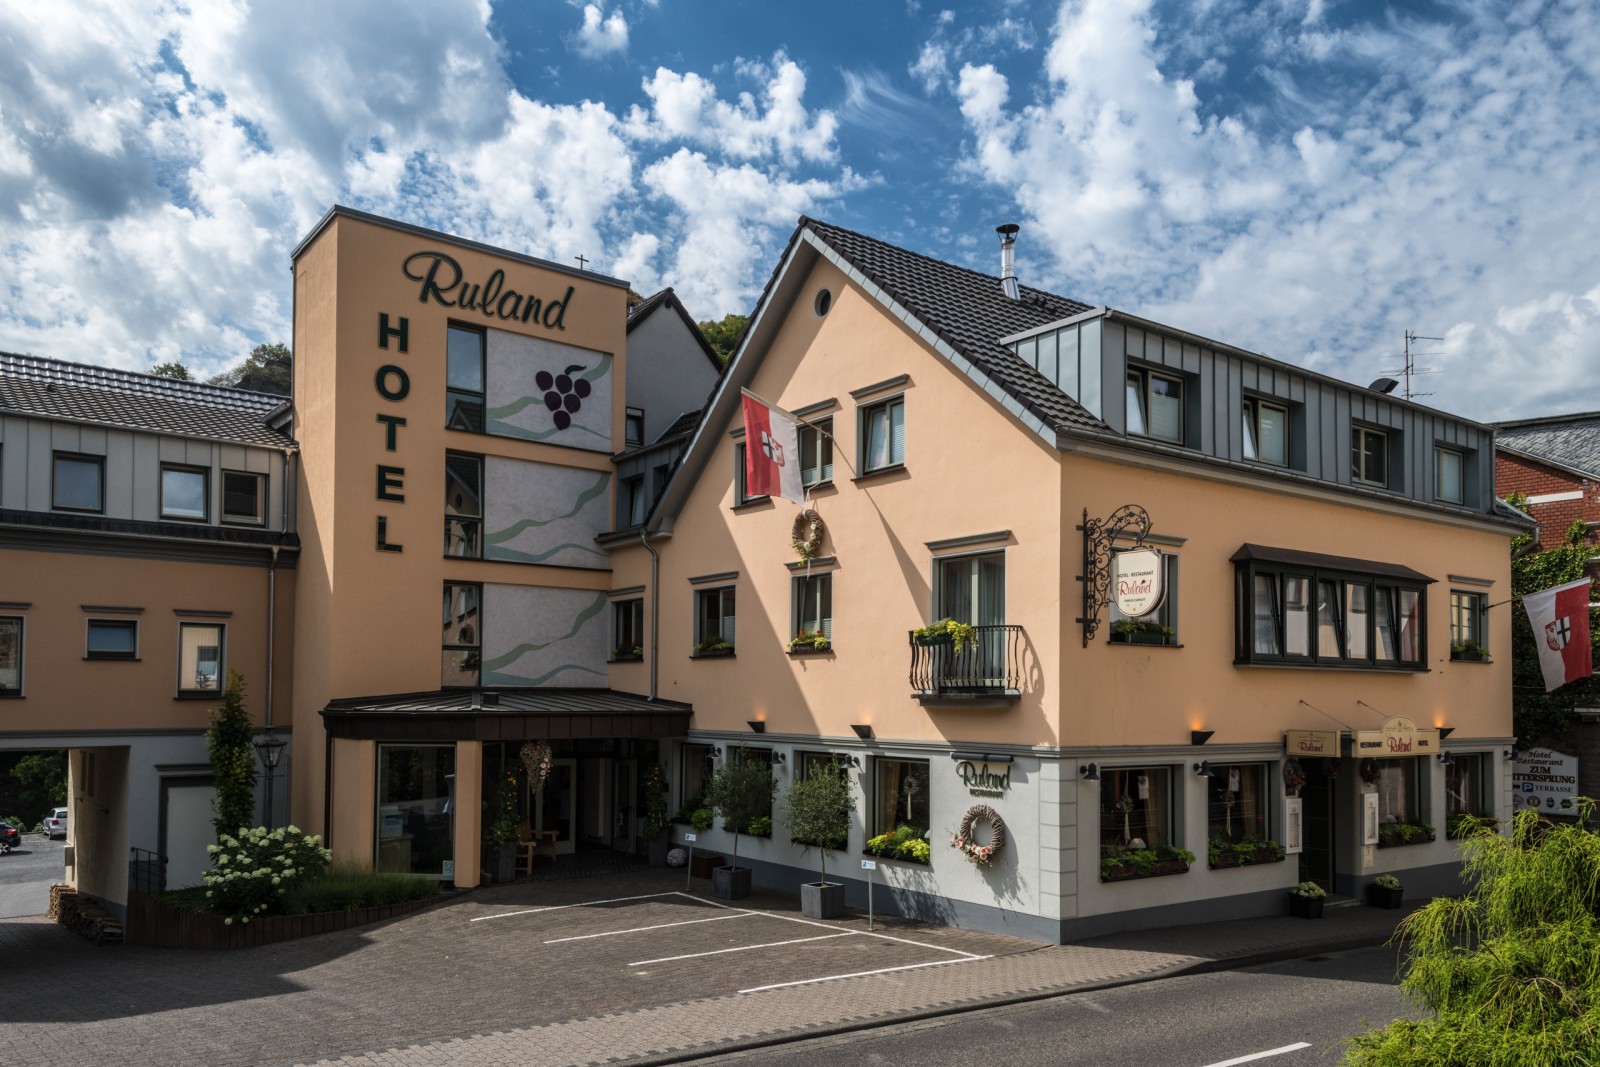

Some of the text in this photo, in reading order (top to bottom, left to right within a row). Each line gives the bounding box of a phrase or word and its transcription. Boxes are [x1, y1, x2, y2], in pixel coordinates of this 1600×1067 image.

[402, 250, 576, 331] Ruland
[374, 311, 411, 554] HOTEL
[1115, 579, 1152, 596] Ruland
[1360, 736, 1429, 753] RESTAURANT Ruland HOTEL
[955, 761, 1012, 791] Ruland
[1513, 772, 1576, 784] ITTERSPRUNG
[1530, 765, 1551, 774] ZUM
